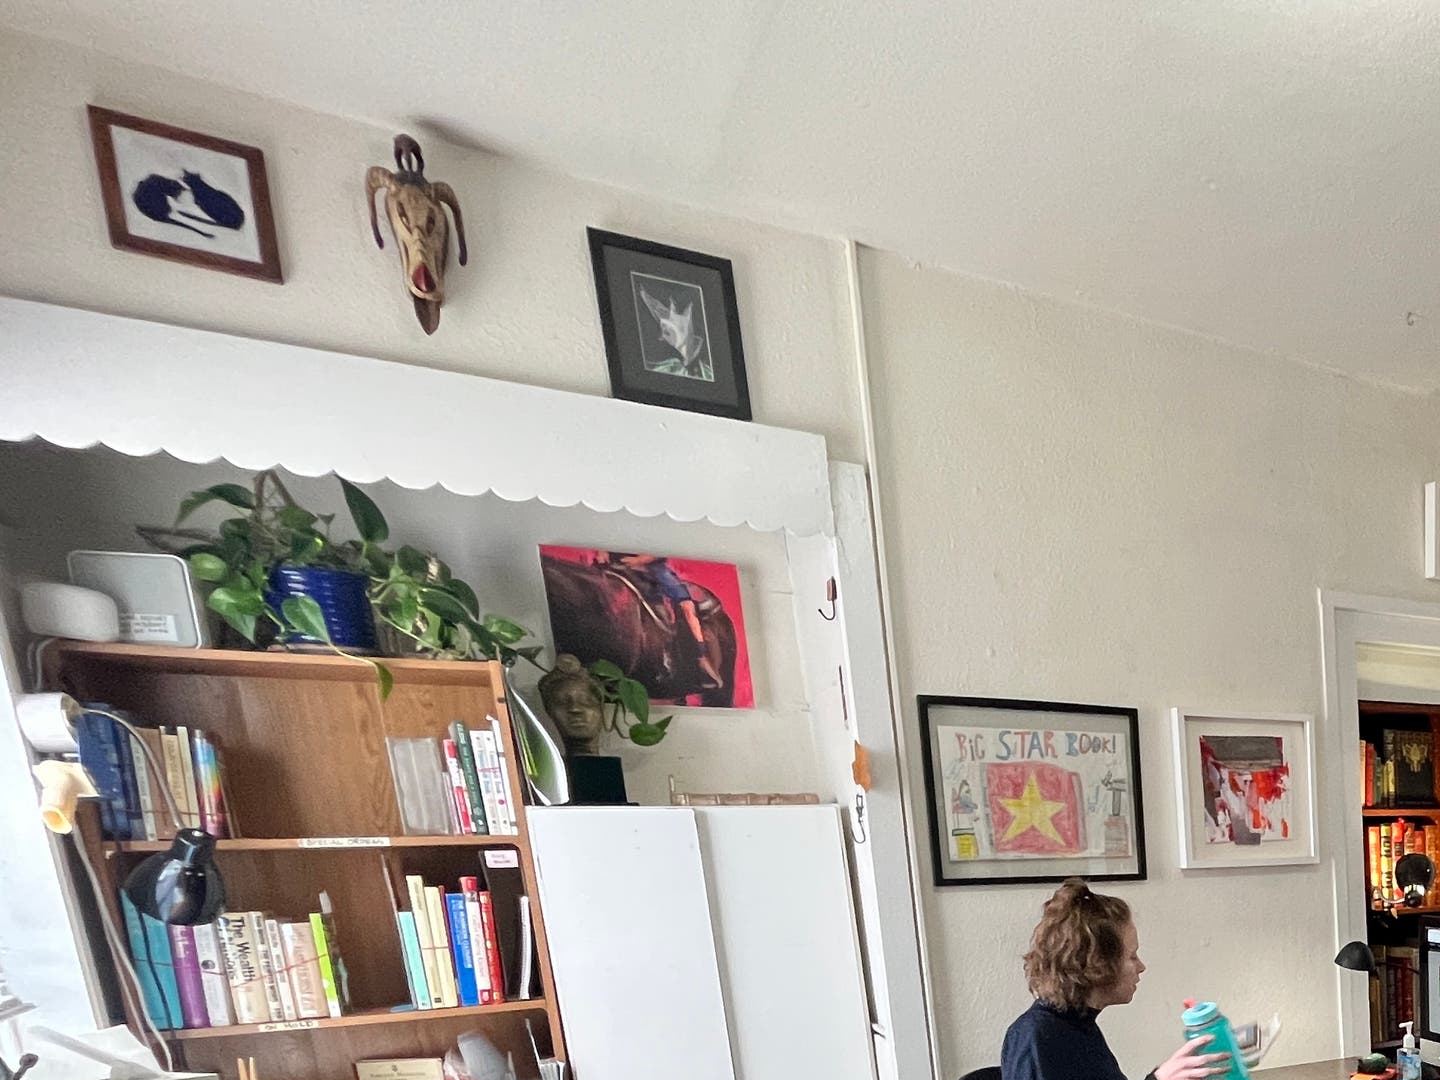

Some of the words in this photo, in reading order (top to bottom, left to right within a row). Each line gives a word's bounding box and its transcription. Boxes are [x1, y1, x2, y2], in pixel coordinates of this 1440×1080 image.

[996, 730, 1058, 760] STAR
[1065, 732, 1117, 757] BOOK!
[231, 916, 245, 936] The
[236, 942, 256, 981] Wealth
